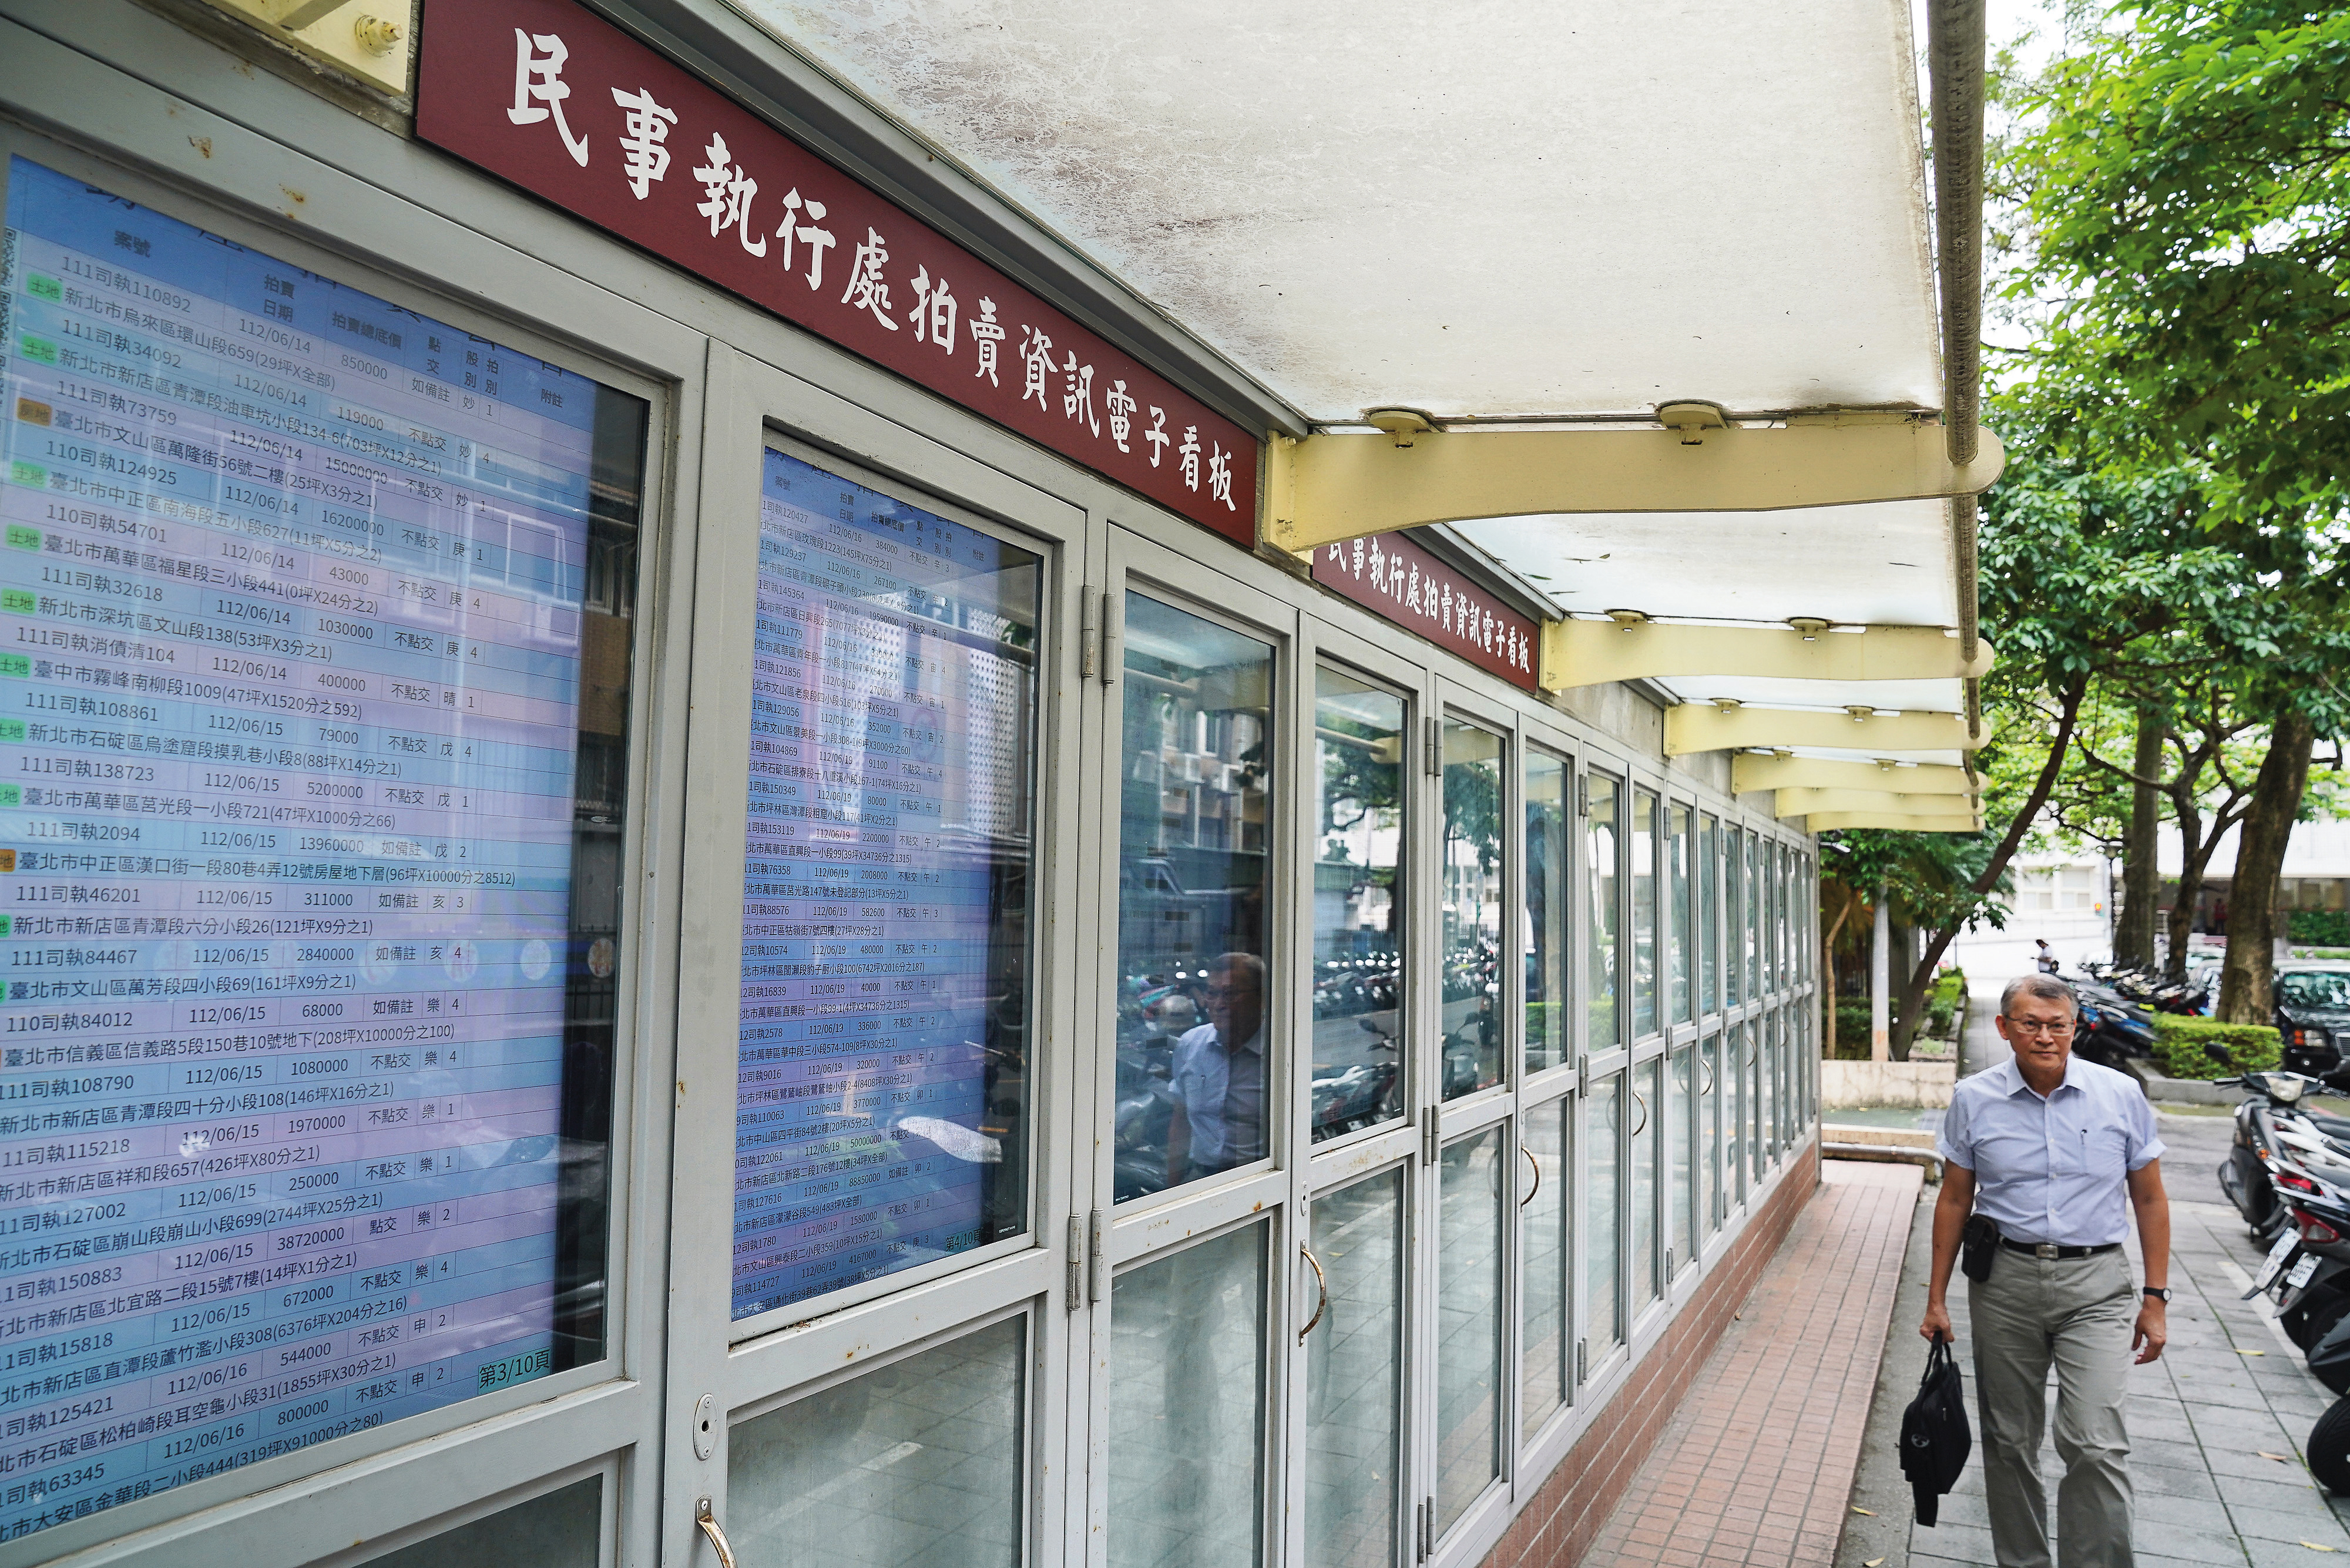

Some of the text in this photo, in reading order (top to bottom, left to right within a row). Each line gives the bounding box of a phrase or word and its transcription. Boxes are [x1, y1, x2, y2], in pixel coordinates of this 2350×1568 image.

[114, 229, 151, 258] 案號
[506, 28, 1236, 511] 民事執行處拍賣資訊電子看板
[30, 277, 61, 301] 土地
[264, 273, 295, 300] 拍賣
[263, 298, 293, 323] 日期
[62, 253, 450, 403] 111司執110892 112/06/14 850000 如備註
[332, 311, 401, 350] 拍賣總底價
[26, 340, 55, 363] 土地
[62, 316, 447, 452] 111司執34092 112/06/14 119000 不點交
[540, 388, 563, 409] 附註
[56, 377, 444, 502] 111司執73759 112/06/14 15000000 不點交
[45, 437, 441, 551] 110司執124925 112/06/14 16200000 不點交
[763, 499, 808, 525] 1司執120427
[46, 501, 438, 601] 110司執54701 112/06/14 43000 不點交
[760, 538, 806, 563] 1司執129237
[4, 592, 33, 612] 土地
[758, 578, 804, 602] 1司執145364
[41, 563, 434, 652] 111司執32618 112/06/14 1030000 不點交
[1328, 536, 1530, 674] 民事執行處拍賣資訊電子看板
[757, 618, 802, 640] 1司執111779
[16, 623, 431, 702] 111司執消債清104 112/06/14 400000 不點交
[754, 658, 801, 679] 1司執121856
[25, 689, 428, 753] 111司執108861 112/06/15 79000 不點交
[753, 699, 799, 718] 1司執129056
[751, 739, 797, 757] 1司執104869
[20, 753, 425, 804] 111司執138723 112/06/15 5200000 不點交
[749, 780, 795, 797] 1司執150349
[26, 819, 422, 856] 111司執2094 112/06/15 13960000 如備註
[747, 821, 794, 837] 1司執153119
[814, 868, 848, 879] 112/06/19
[15, 884, 419, 908] 111司執46201 112/06/15 311000 如備註
[813, 907, 847, 917] 112/06/19
[11, 946, 417, 969] 111司執84467 112/06/15 2840000 如備註
[811, 946, 845, 956] 112/06/19
[810, 985, 844, 996] 112/06/19
[6, 999, 415, 1035] 110司執84012 112/06/15 68000 如備註
[740, 1023, 843, 1042] 12司執2578 112/06/19
[184, 1065, 263, 1087] 112/06/15
[290, 1059, 348, 1076] 1080000
[371, 1052, 412, 1070] 不點交
[738, 1059, 879, 1084] 12司執9016 112/06/19 320000
[736, 1096, 880, 1127] 9司執110063 112/06/19 3770000
[3, 1105, 409, 1169] 11司執115218 112/06/15 1970000 不點交
[735, 1134, 881, 1169] 0司執122061 112/06/19 50000000
[177, 1183, 256, 1211] 112/06/15
[288, 1172, 338, 1193] 250000
[365, 1160, 407, 1181] 不點交
[804, 1180, 838, 1197] 112/06/19
[850, 1172, 880, 1187] 88850000
[733, 1210, 877, 1255] 12司執1780 112/06/19 1580000
[945, 1227, 981, 1252] 第4/10頁
[1, 1215, 398, 1305] 1司執150883 112/06/15 38720000 點交
[801, 1259, 837, 1279] 112/06/19
[849, 1249, 876, 1265] 4167000
[170, 1302, 250, 1335] 112/06/15
[283, 1285, 334, 1309] 672000
[360, 1268, 402, 1292] 不點交
[167, 1362, 247, 1398] 112/06/16
[280, 1342, 331, 1368] 544000
[358, 1322, 400, 1348] 不點交
[478, 1347, 550, 1391] 第3/10頁
[164, 1422, 244, 1461] 112/06/16
[277, 1399, 328, 1427] 800000
[355, 1377, 398, 1405] 不點交
